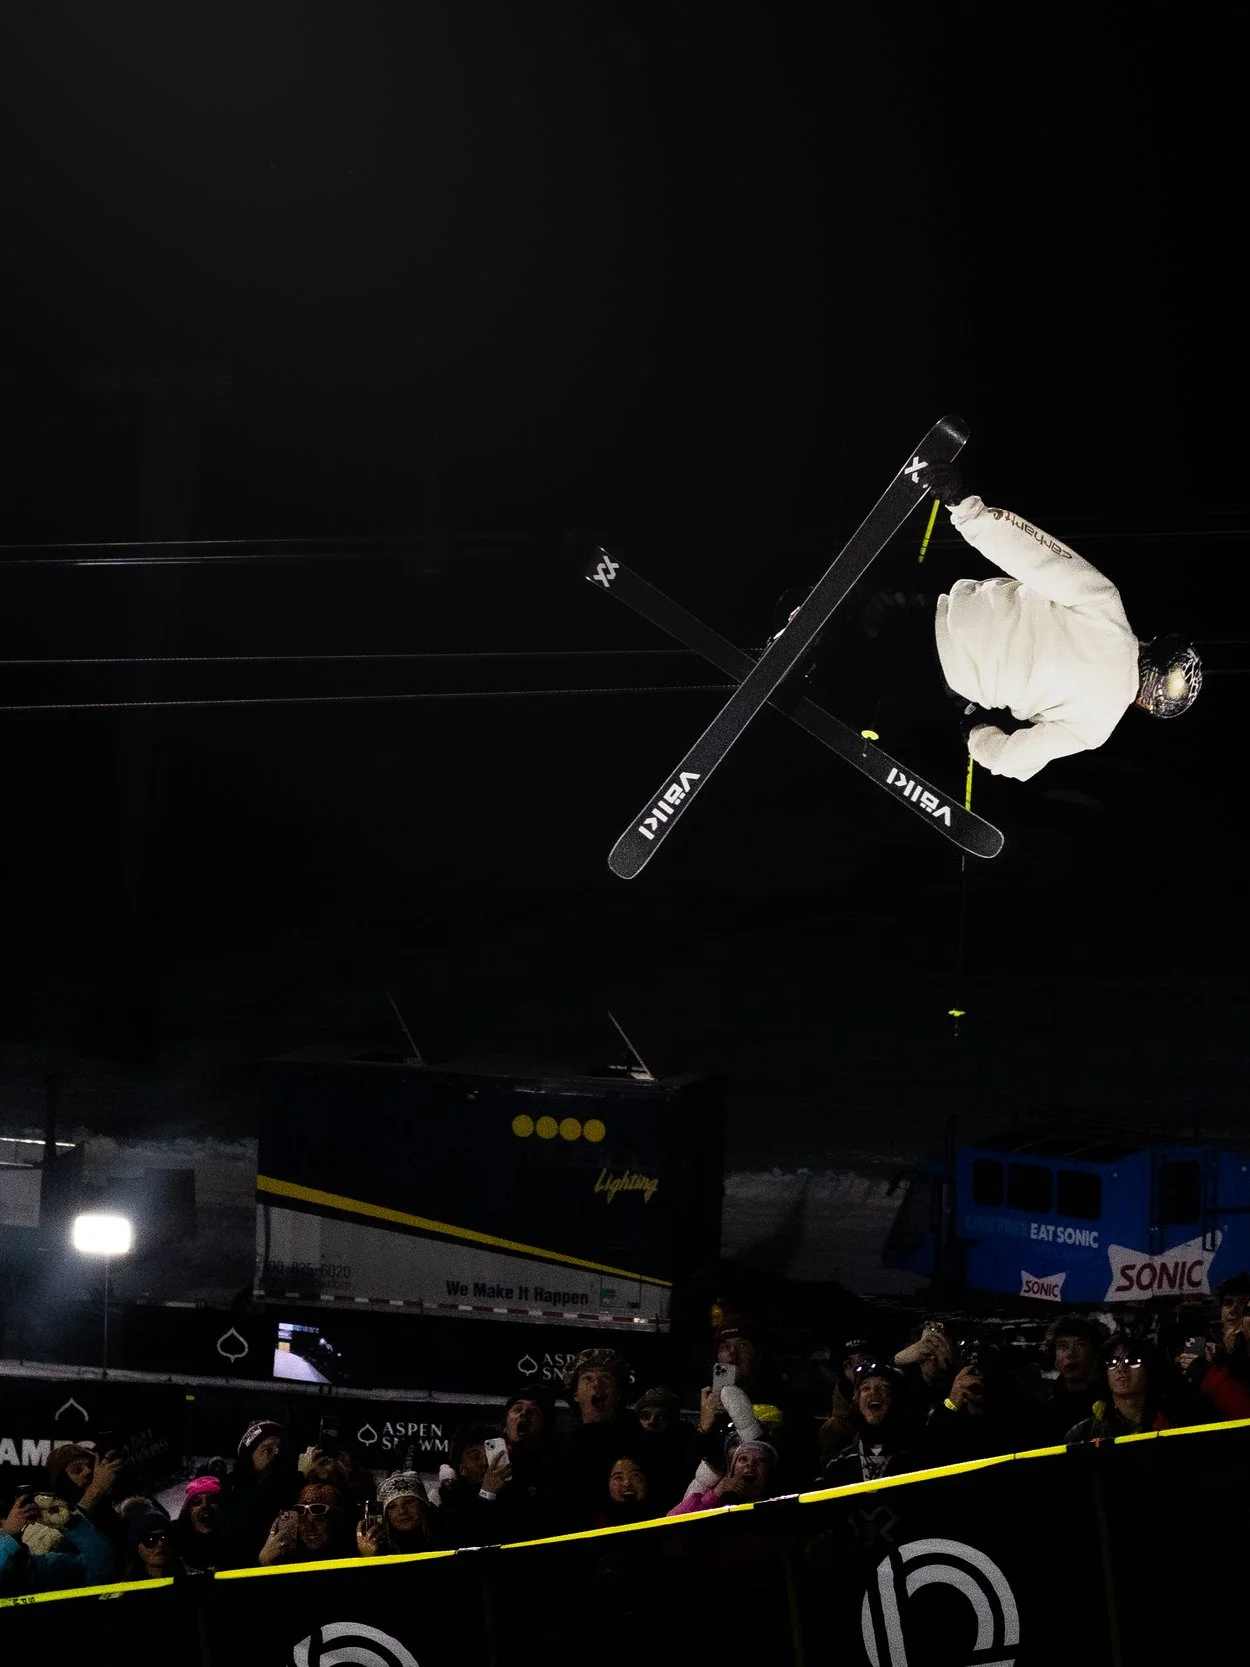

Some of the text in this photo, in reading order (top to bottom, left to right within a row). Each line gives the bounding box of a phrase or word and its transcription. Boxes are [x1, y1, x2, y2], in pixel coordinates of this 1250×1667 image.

[1004, 511, 1073, 559] carhartt
[594, 1167, 660, 1205] Lighting
[1029, 1222, 1056, 1242] EAT
[1056, 1227, 1100, 1249] SONIC
[1023, 1279, 1061, 1298] SONIC
[1115, 1260, 1205, 1292] SONIC
[446, 1280, 590, 1307] We Make It Happen
[542, 1353, 577, 1367] ASP
[382, 1421, 443, 1437] ASPEN
